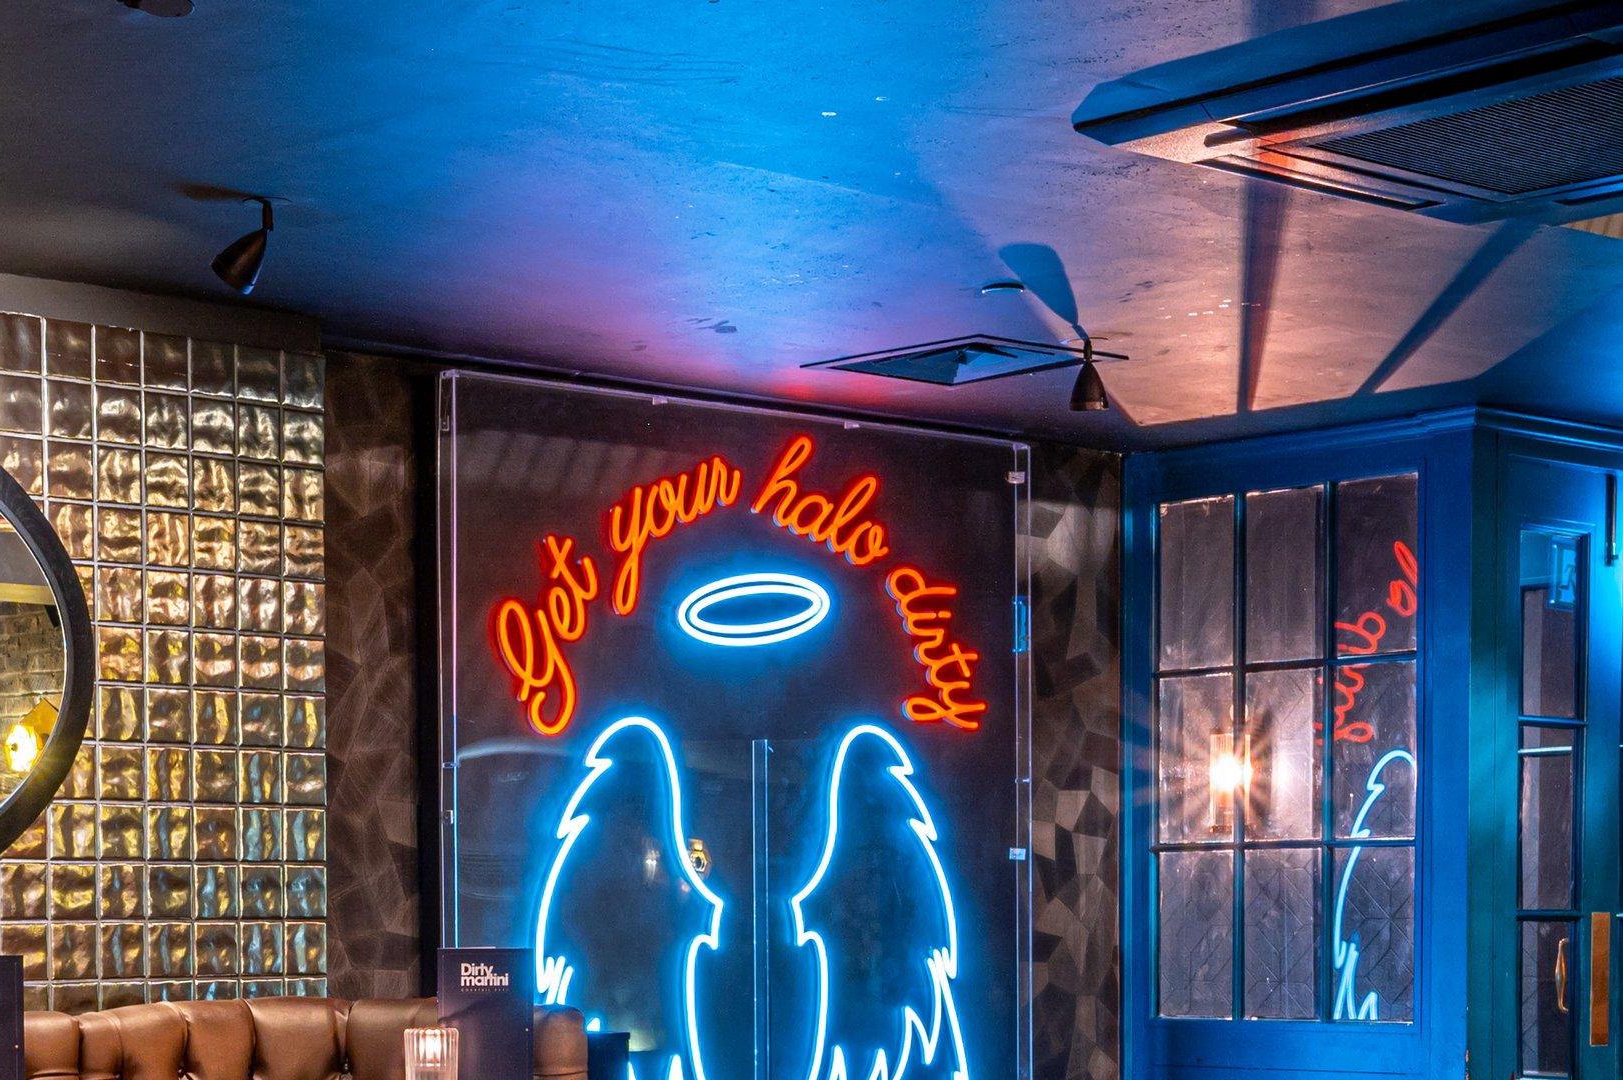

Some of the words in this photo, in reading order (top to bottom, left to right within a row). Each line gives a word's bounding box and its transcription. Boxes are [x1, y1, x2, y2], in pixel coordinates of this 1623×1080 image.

[492, 532, 598, 736] Get
[608, 455, 741, 615] your
[750, 434, 890, 567] halo
[886, 566, 987, 731] dirty
[460, 963, 494, 977] Dirty
[460, 973, 509, 987] martini
